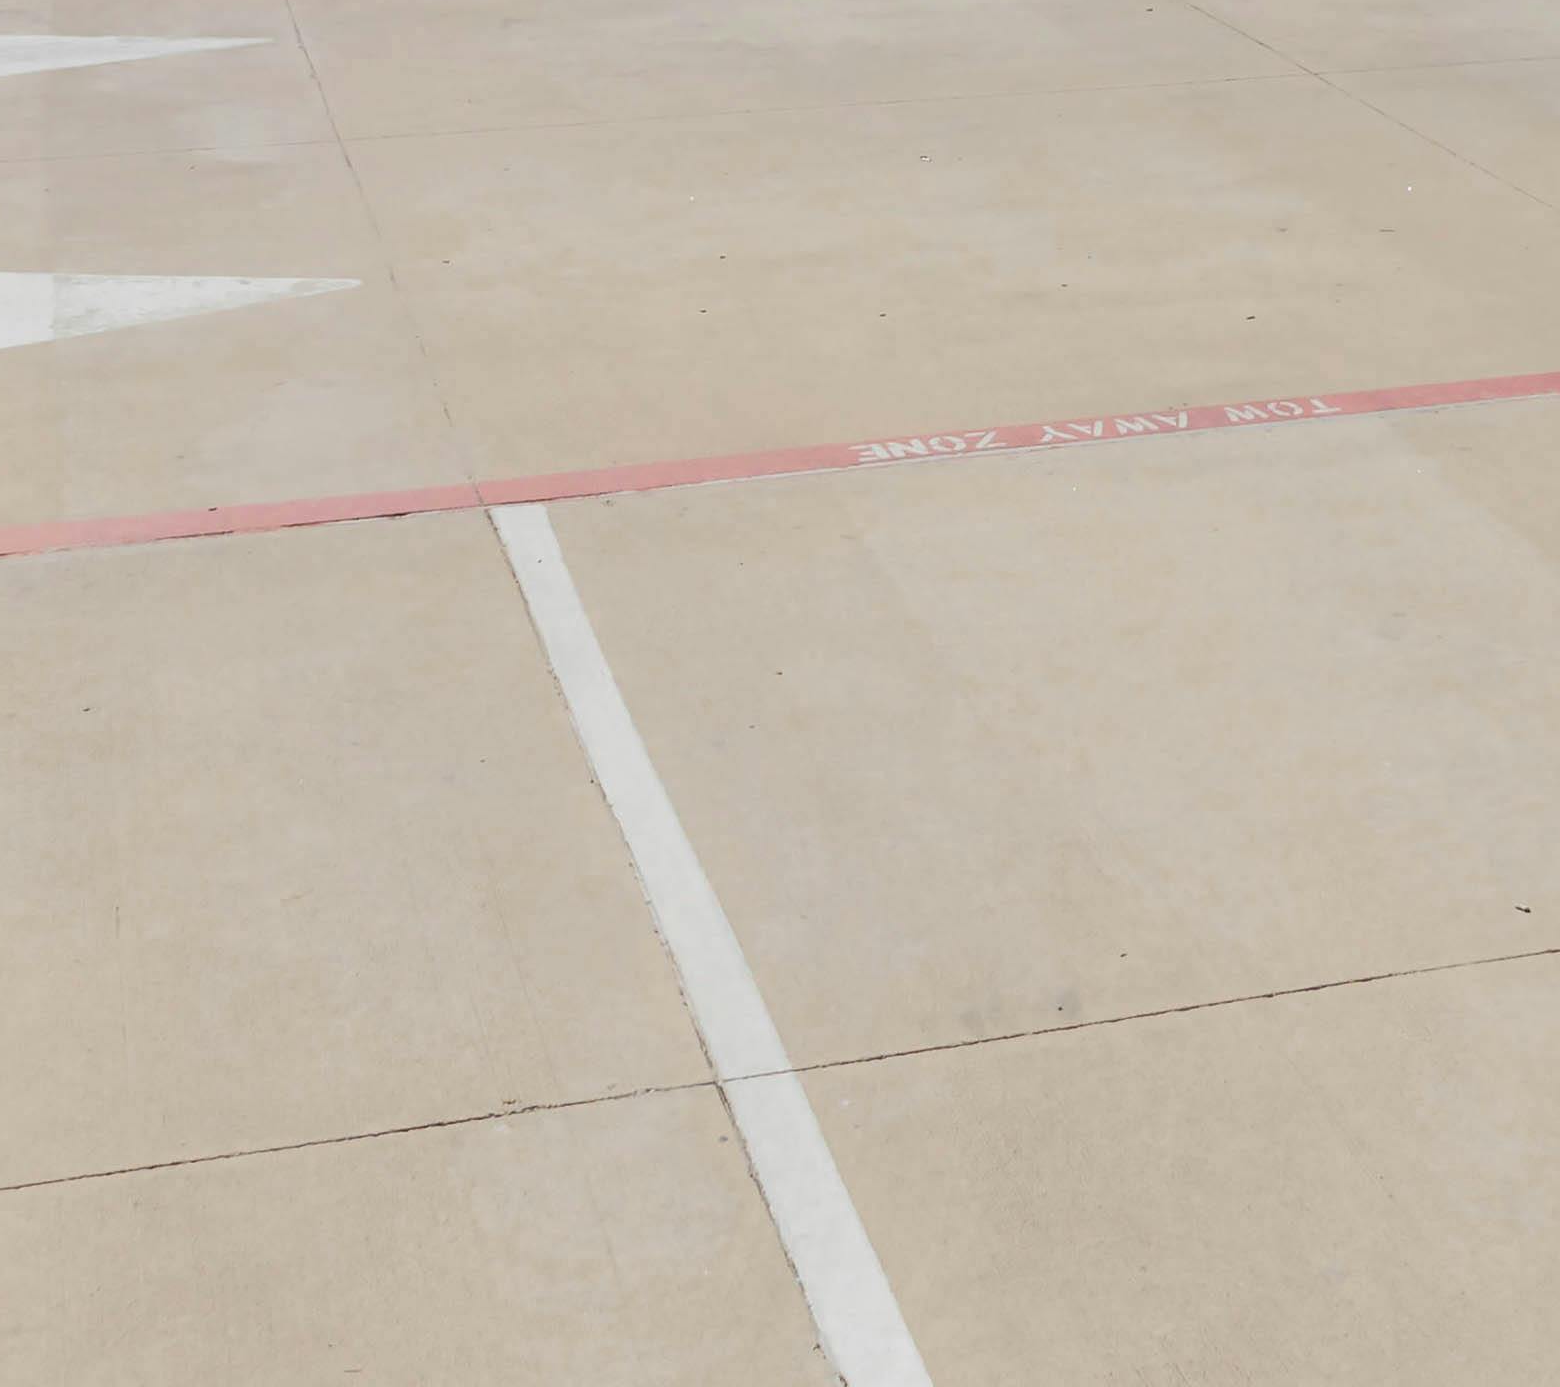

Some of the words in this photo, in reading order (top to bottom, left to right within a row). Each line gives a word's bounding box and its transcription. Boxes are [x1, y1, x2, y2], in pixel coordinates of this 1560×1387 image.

[1224, 398, 1341, 422] TOW
[1041, 410, 1189, 444] AWAY
[848, 430, 1008, 463] ZONE
